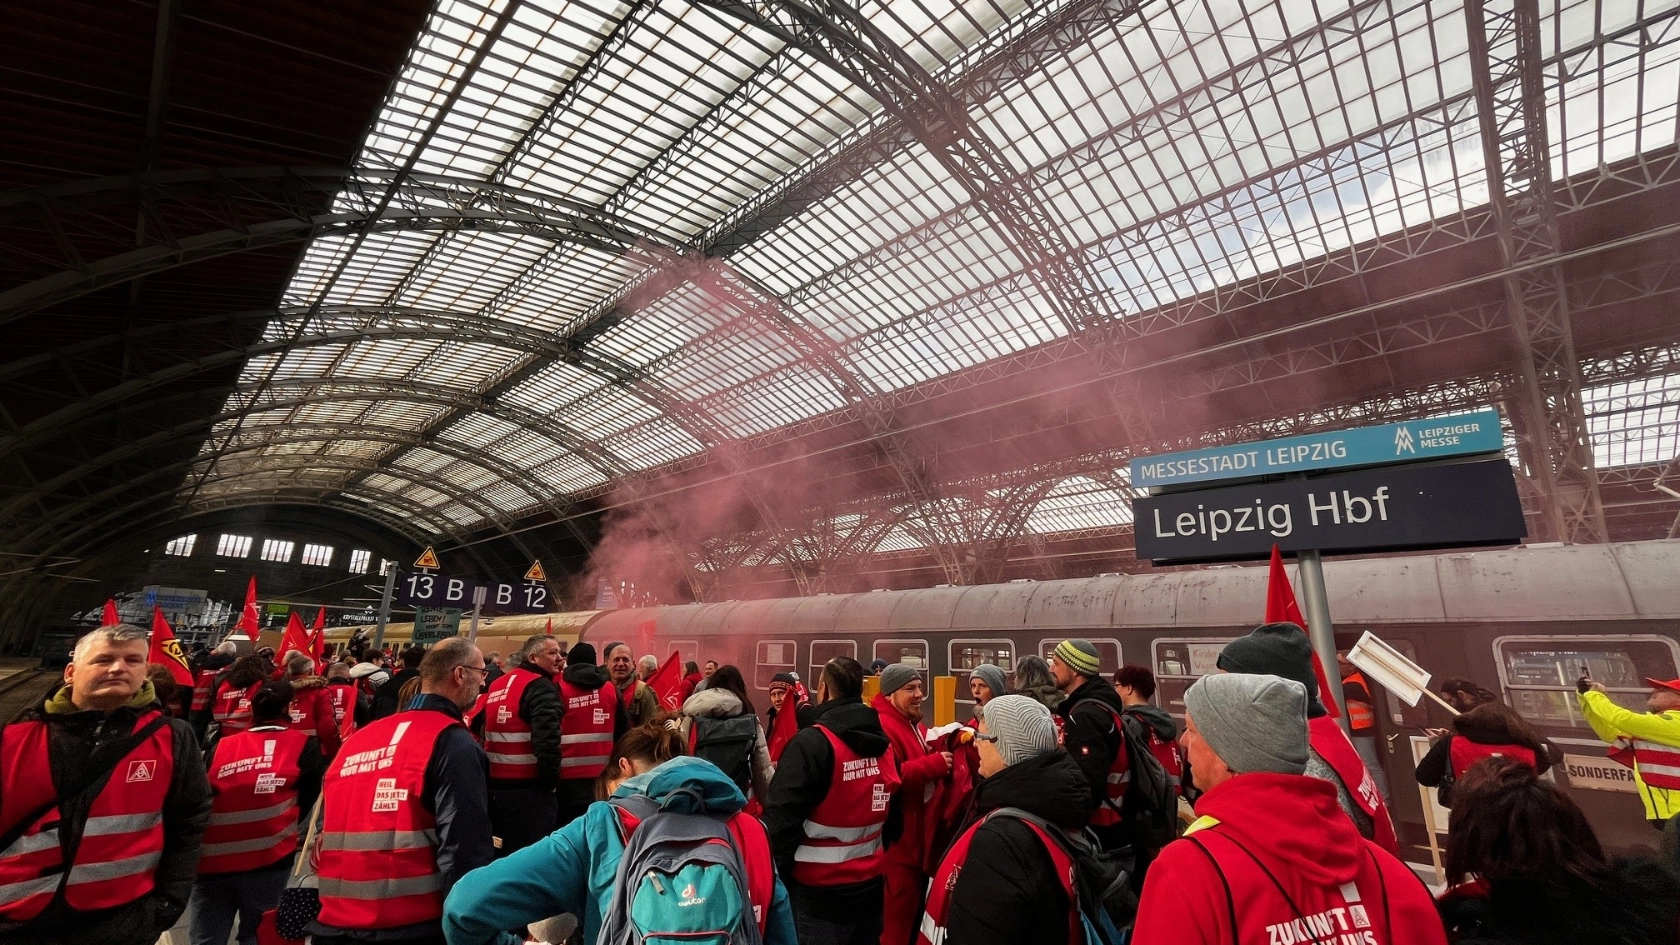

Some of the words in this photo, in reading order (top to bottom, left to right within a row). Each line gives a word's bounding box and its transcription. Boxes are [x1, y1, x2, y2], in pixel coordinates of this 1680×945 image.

[1419, 423, 1480, 439] LEIPZIGER
[1421, 436, 1460, 448] MESSE
[1141, 450, 1258, 480] MESSESTADT
[1266, 440, 1347, 467] LEIPZIG
[1153, 498, 1292, 542] Leipzig
[1308, 486, 1389, 526] Hbf
[407, 575, 434, 599] 13
[446, 578, 464, 601] B
[496, 583, 513, 605] B
[524, 586, 547, 608] 12
[219, 755, 263, 772] ZUKUNFT
[236, 764, 254, 773] MIT
[254, 761, 272, 770] UNS
[342, 747, 387, 768] ZUKUNFT
[843, 757, 870, 772] ZUKUNFT
[340, 765, 359, 778] NUR
[358, 761, 377, 773] MIT
[378, 757, 394, 770] UNS
[843, 771, 856, 782] NUR
[856, 769, 865, 779] MIT
[866, 766, 880, 777] UNS
[379, 780, 393, 788] WEIL
[1265, 907, 1349, 945] ZUKUNFT
